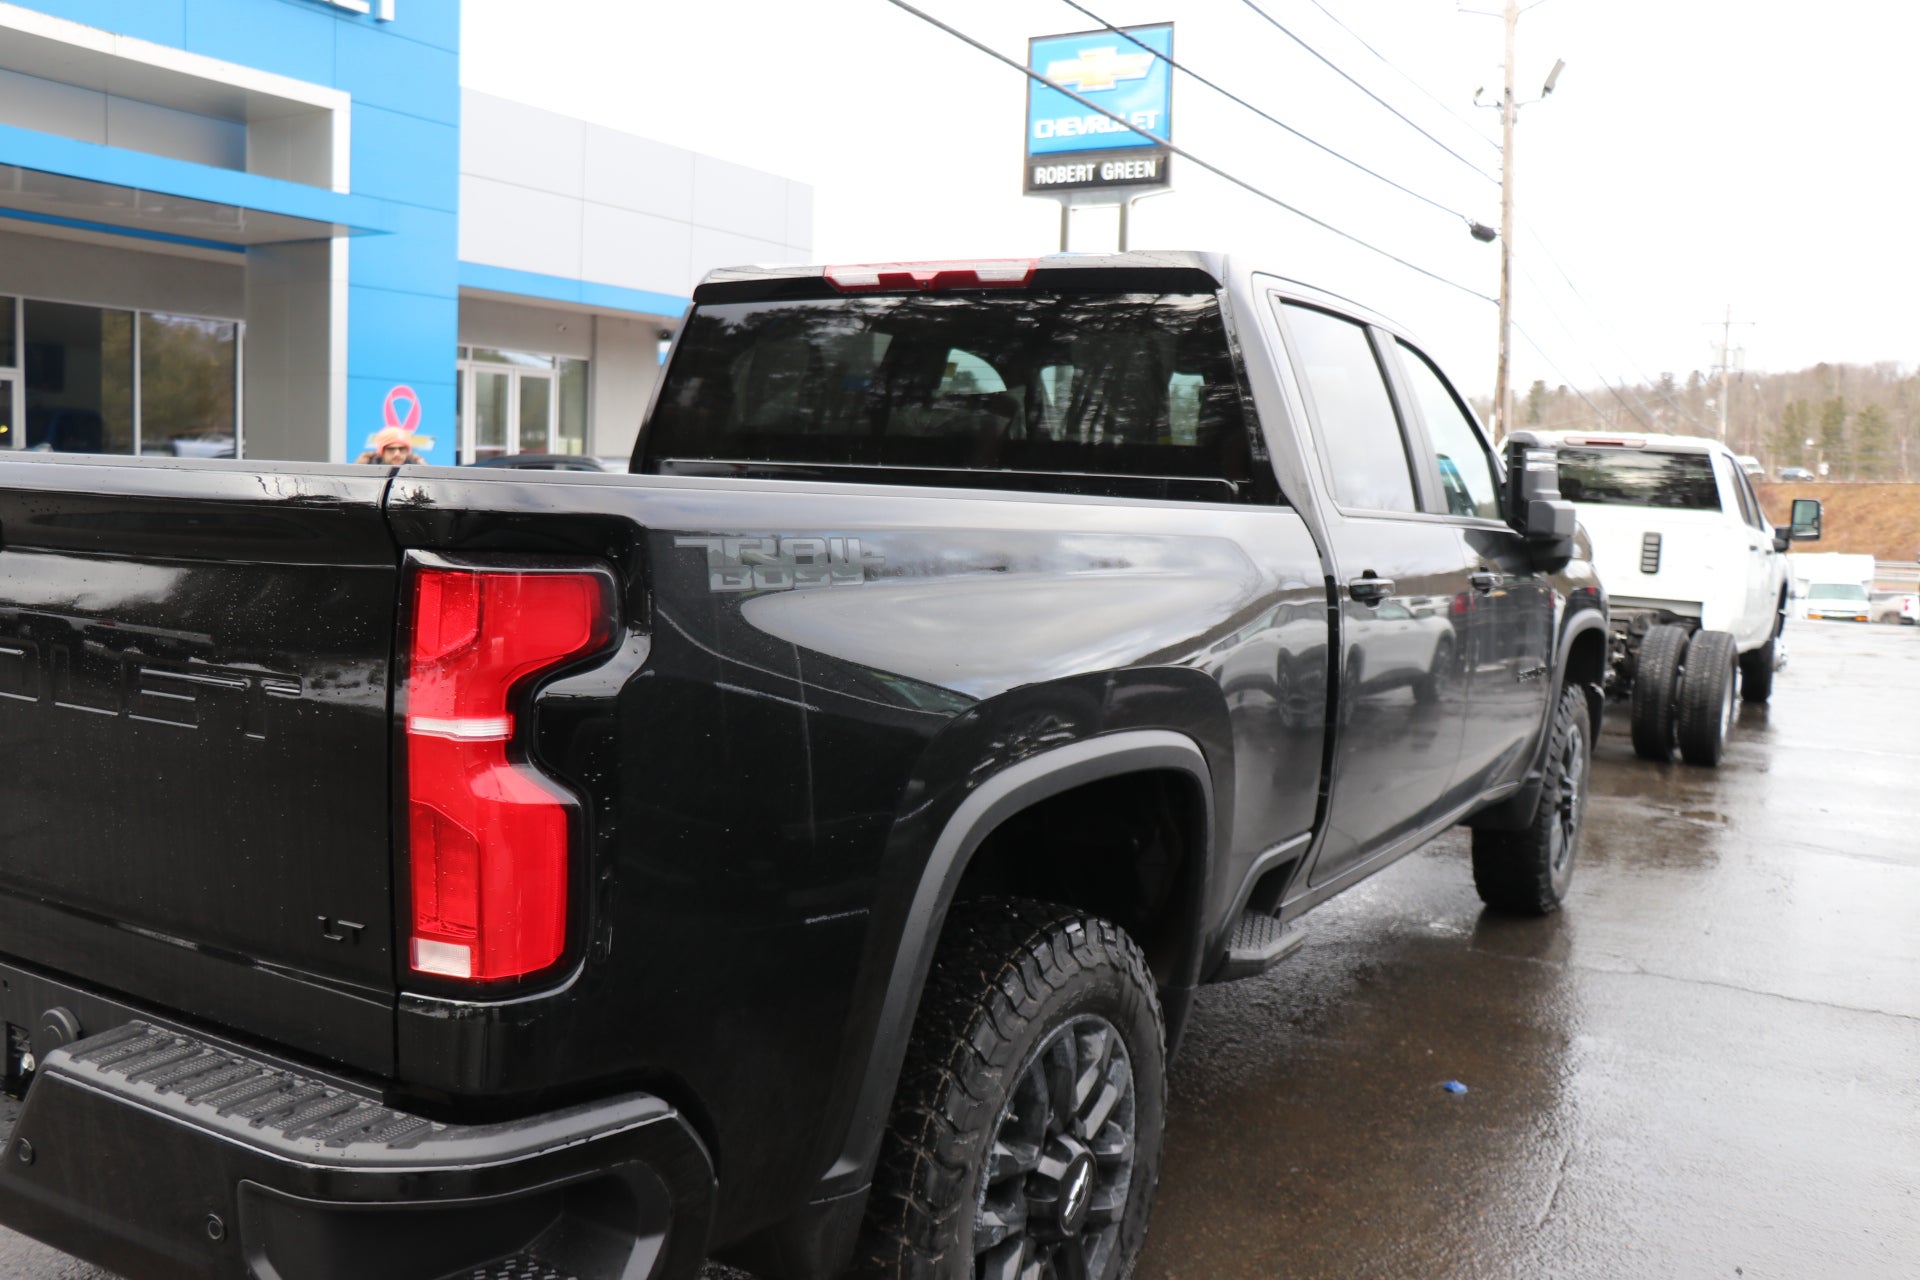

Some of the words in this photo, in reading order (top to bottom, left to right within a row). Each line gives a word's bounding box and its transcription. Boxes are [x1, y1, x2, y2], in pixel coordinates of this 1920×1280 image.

[1034, 110, 1160, 139] CHEVROLET
[1034, 163, 1095, 185] ROBERT
[1101, 160, 1156, 181] GREEN
[674, 537, 885, 567] TRAIL
[708, 564, 865, 593] BOSS
[317, 915, 367, 945] LT
